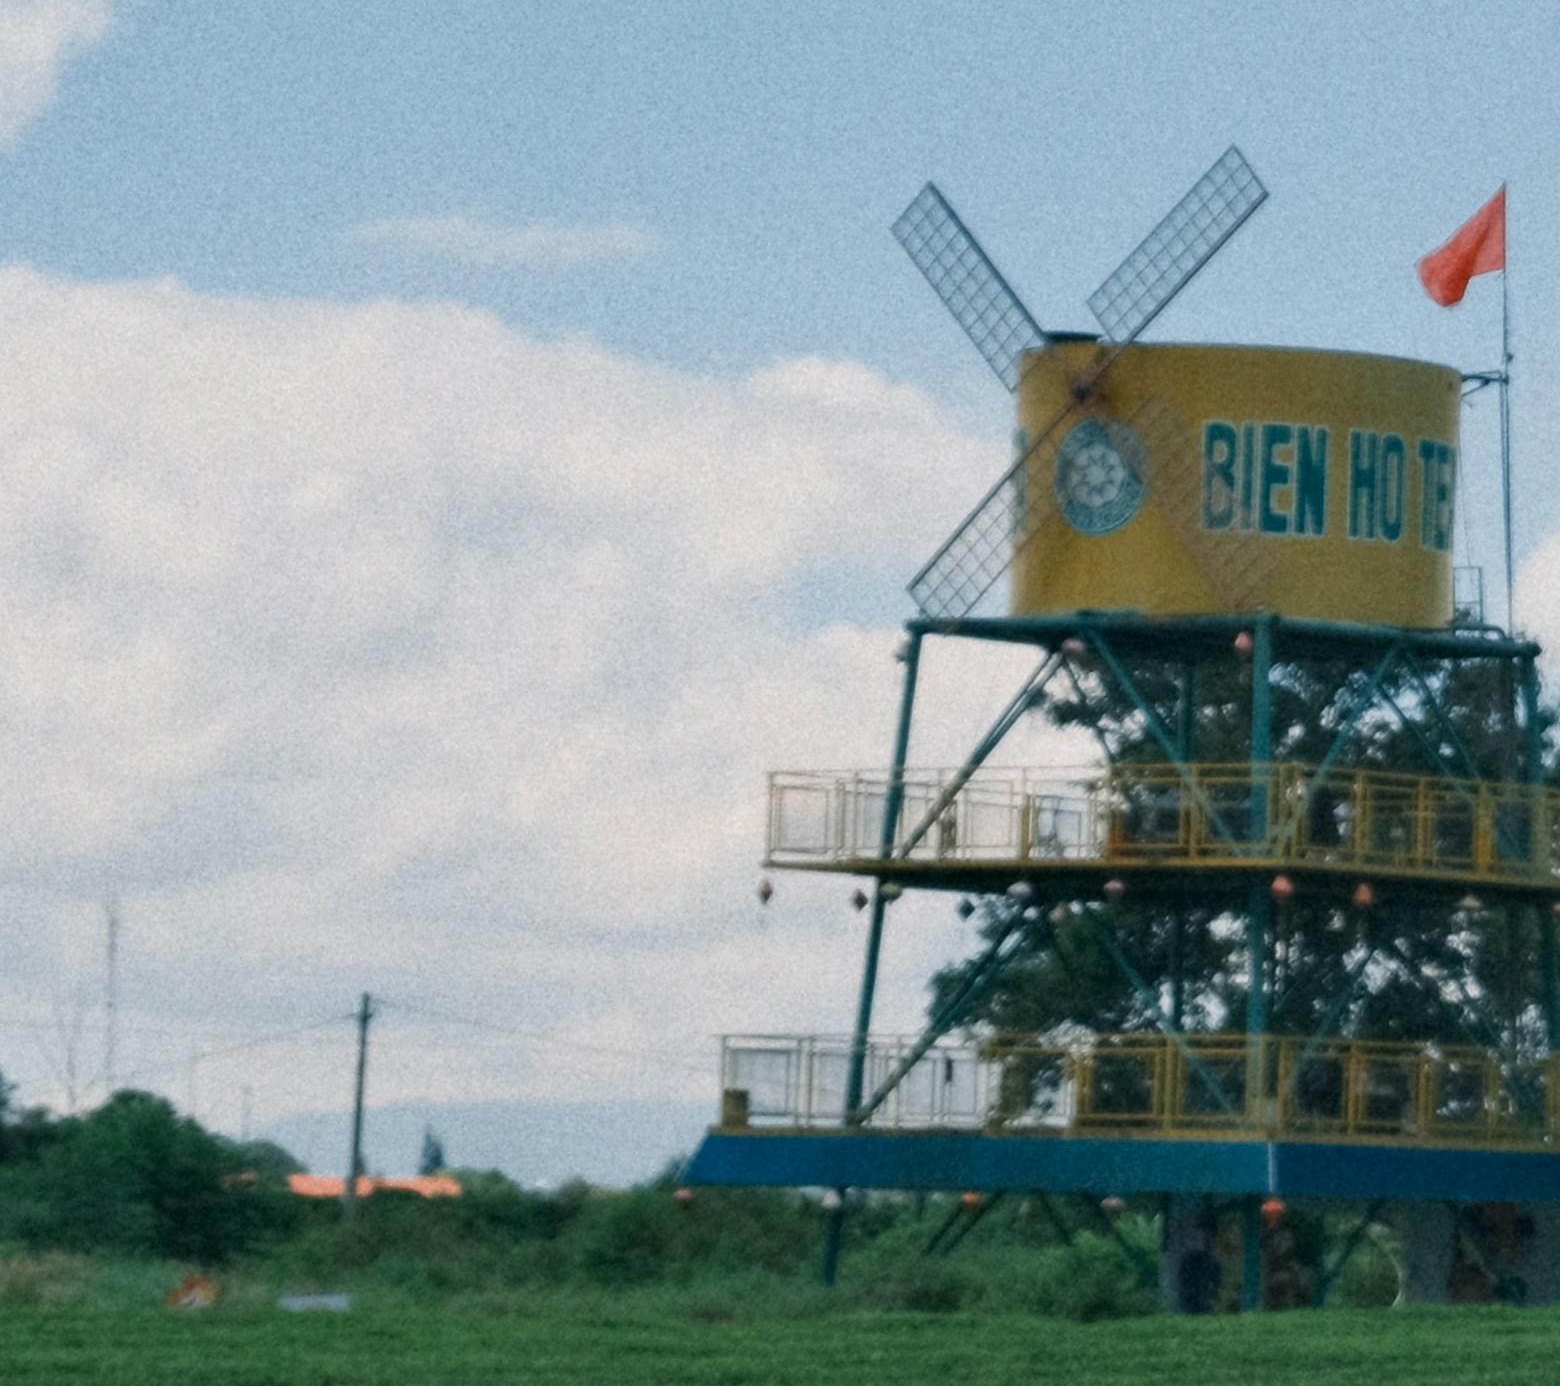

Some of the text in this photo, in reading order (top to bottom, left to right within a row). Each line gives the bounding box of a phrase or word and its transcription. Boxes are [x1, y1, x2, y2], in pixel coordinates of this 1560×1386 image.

[1203, 421, 1326, 536] BIEN
[1349, 429, 1405, 542] HO
[1419, 439, 1455, 551] TE
